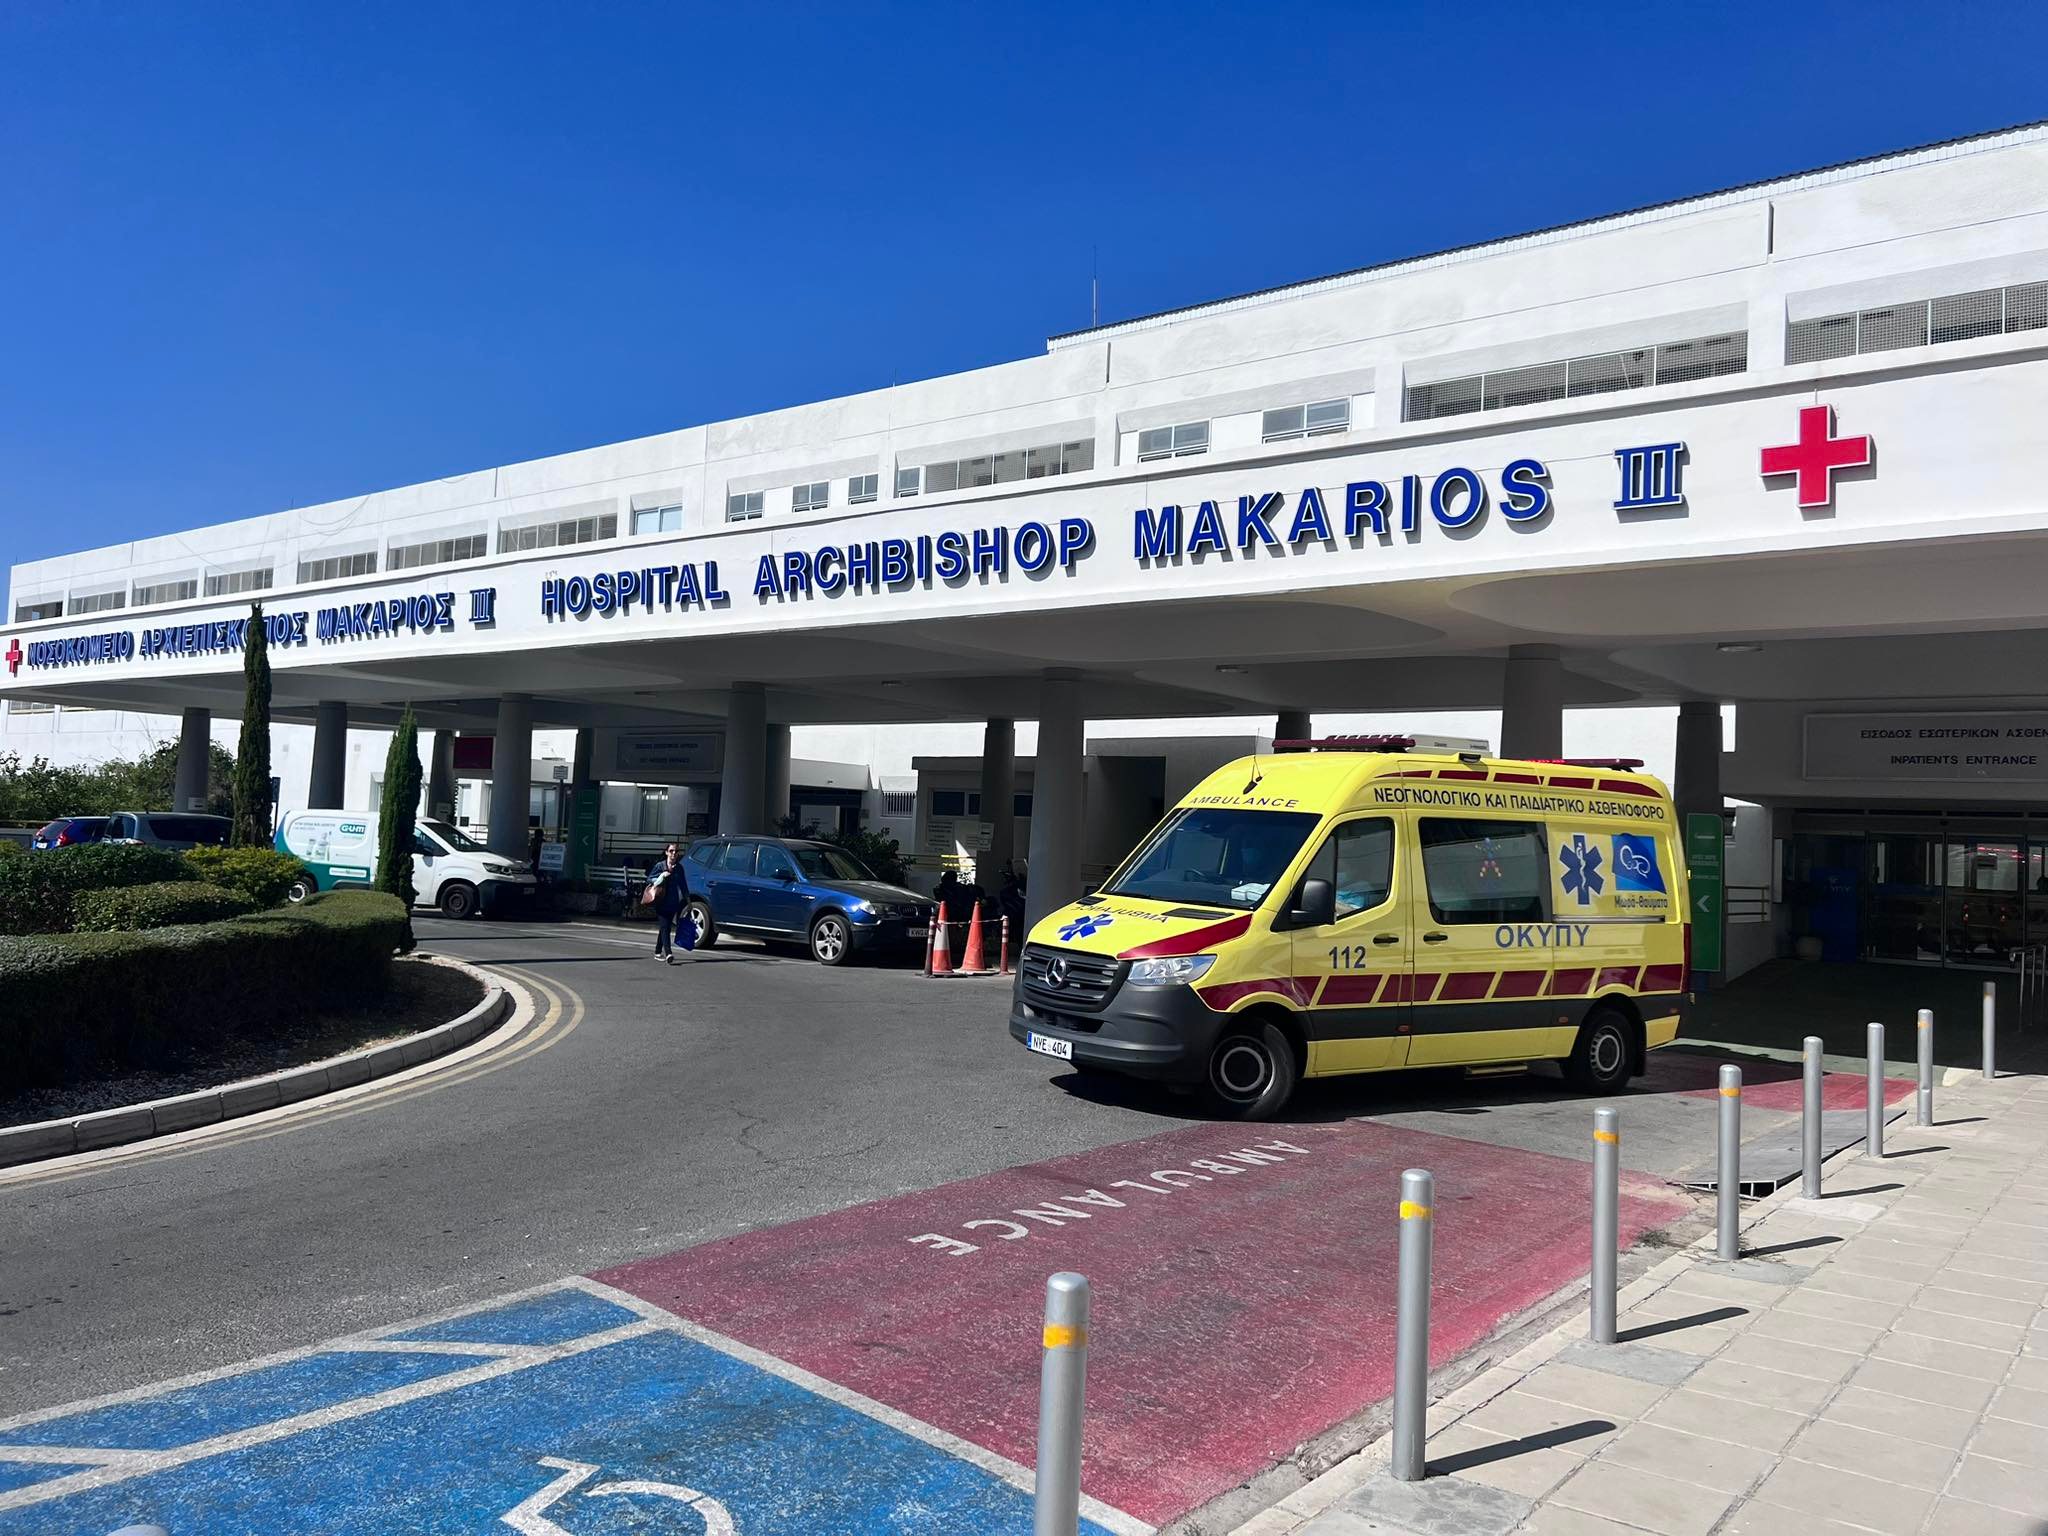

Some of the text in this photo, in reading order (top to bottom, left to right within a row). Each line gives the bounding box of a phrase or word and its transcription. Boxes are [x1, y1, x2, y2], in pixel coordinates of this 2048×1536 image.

[541, 441, 1684, 616] HOSPITAL ARCHBISHOP MAKARIOS III
[28, 631, 132, 666] ΝΟΣΟΚΟΜΕΙΟ
[316, 592, 455, 640] ΜΑΚΑΡΙΟΣ
[1860, 729, 1913, 739] ΕΙΣΟΔΟΣ
[1918, 728, 1999, 739] ΕΣΩΤΕΡΙΚΩΝ
[1890, 755, 2038, 765] INPATIENTS ENTRANCE
[1190, 796, 1300, 809] AMBULANCE
[1373, 787, 1665, 820] ΝΕΟΓΝΟΛΟΓΙΚΟ ΚΑΙ ΠΑΙΔΙΑΤΡΙΚΟ ΑΣΘΕΝΟΦΟΡΟ
[1495, 924, 1591, 949] ΟΚΥΠΥ
[1328, 945, 1367, 970] 112
[1033, 1036, 1068, 1057] NYE 404
[907, 1139, 1311, 1256] AMBULANCE
